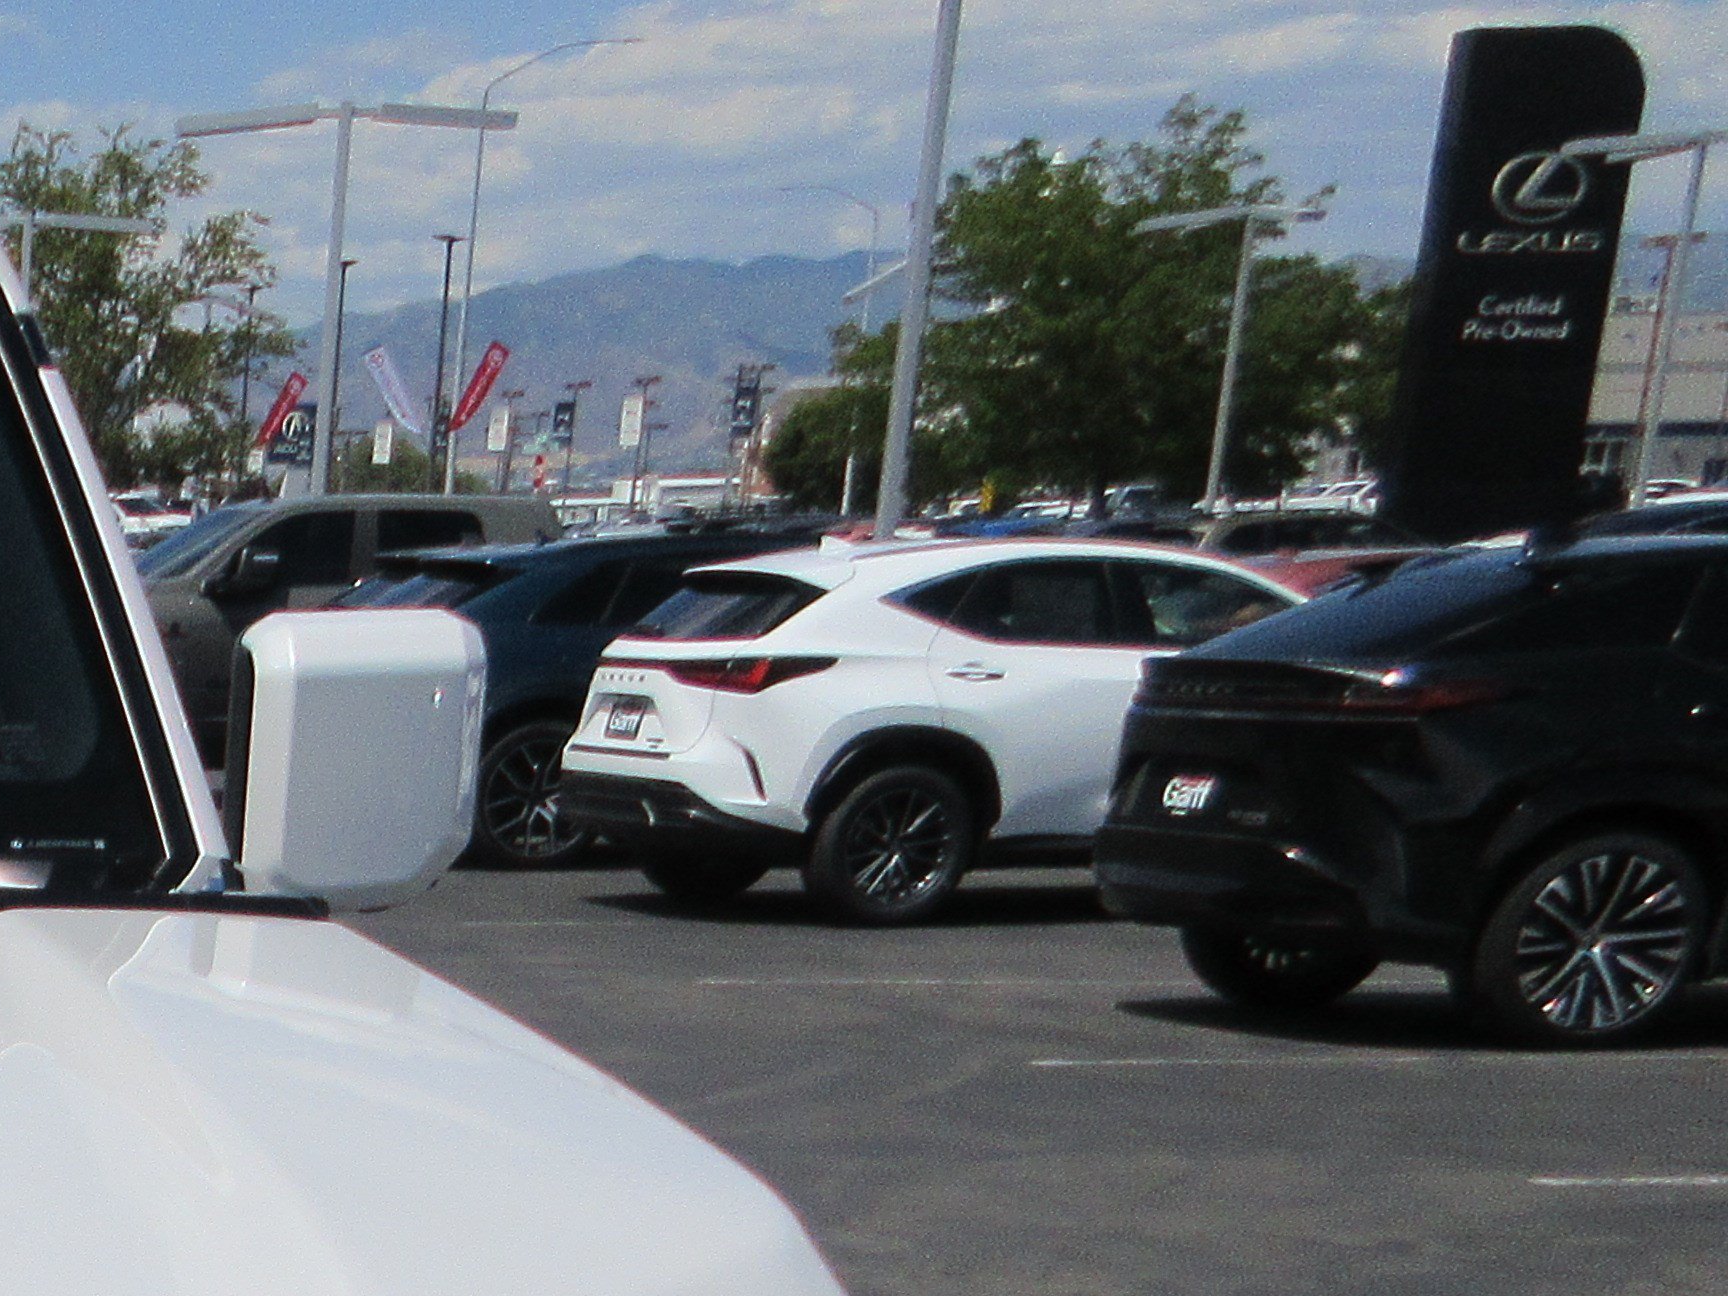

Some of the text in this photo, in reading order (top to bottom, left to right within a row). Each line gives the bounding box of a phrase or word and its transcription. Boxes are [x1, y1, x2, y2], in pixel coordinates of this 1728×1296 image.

[1457, 231, 1601, 252] LEXUS
[1478, 294, 1564, 316] Certified
[1461, 318, 1571, 341] Pre-Owned
